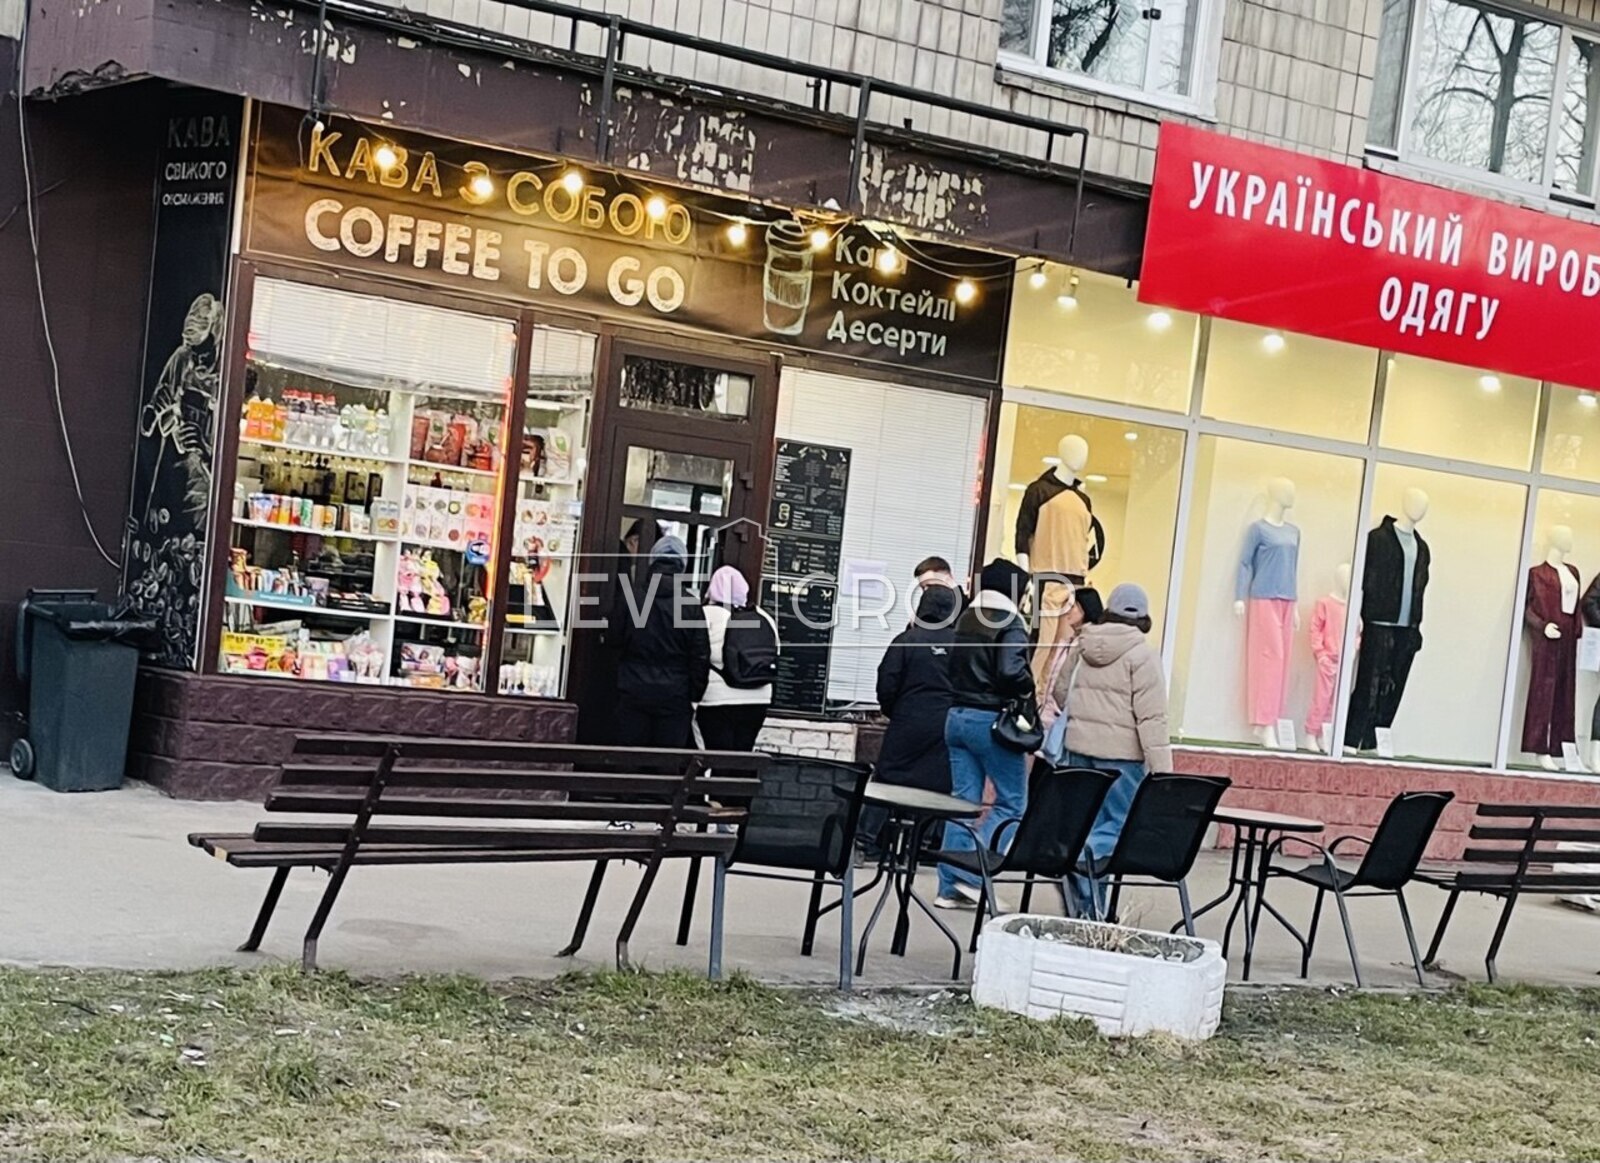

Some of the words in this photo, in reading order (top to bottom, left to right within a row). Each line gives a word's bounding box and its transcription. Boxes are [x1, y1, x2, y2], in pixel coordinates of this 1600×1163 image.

[167, 115, 231, 148] КАВА
[308, 129, 443, 198] КАВА
[506, 171, 692, 245] СОБОЮ
[1189, 161, 1464, 267] УКРАЇНСЬКИЙ
[304, 199, 503, 281] COFFEE
[523, 239, 589, 296] TO
[606, 256, 686, 314] GO
[835, 232, 908, 276] Каа
[831, 270, 957, 322] Коктейлі
[1379, 277, 1499, 341] ОДЯГУ
[827, 310, 947, 357] Десерти
